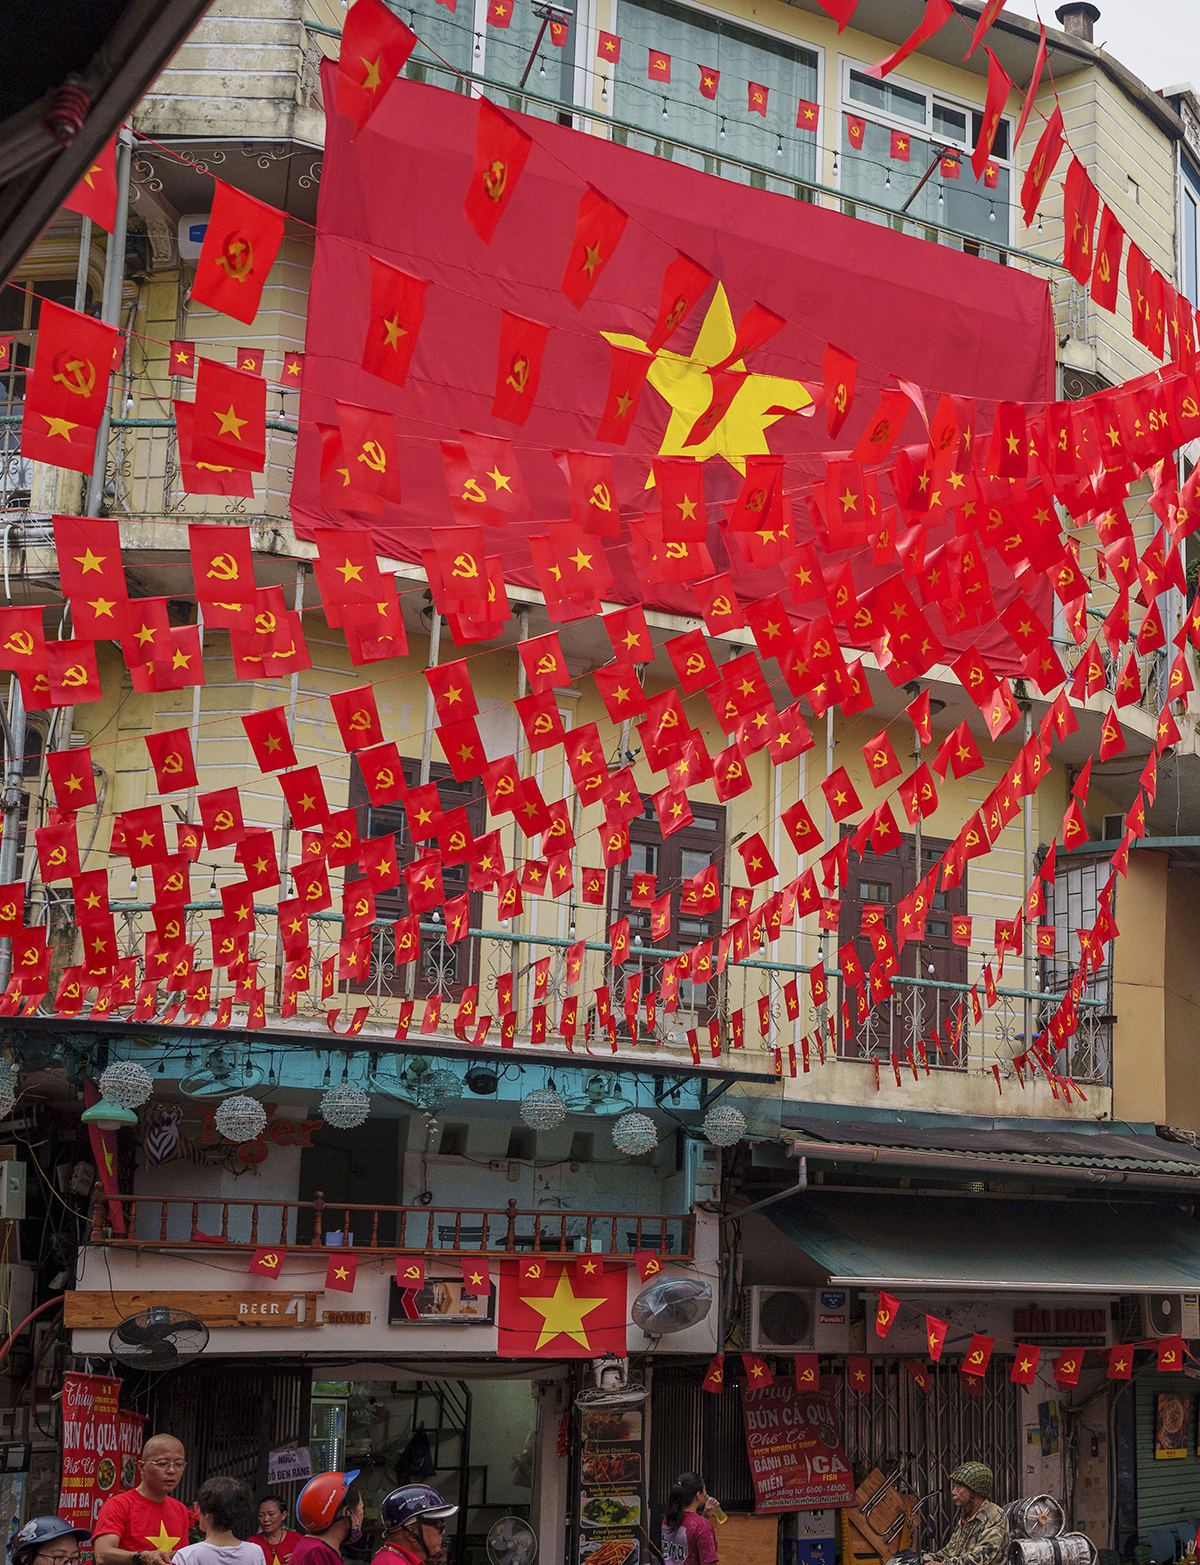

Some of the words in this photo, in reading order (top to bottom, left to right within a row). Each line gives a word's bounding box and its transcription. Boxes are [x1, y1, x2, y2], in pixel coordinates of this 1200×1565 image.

[240, 1303, 279, 1314] BEER
[746, 1405, 779, 1430] BÚN
[753, 1448, 770, 1456] FISH
[770, 1443, 797, 1453] NOODLE
[799, 1440, 817, 1449] SOUP
[822, 1473, 838, 1481] FISH
[826, 1484, 846, 1492] 14h00
